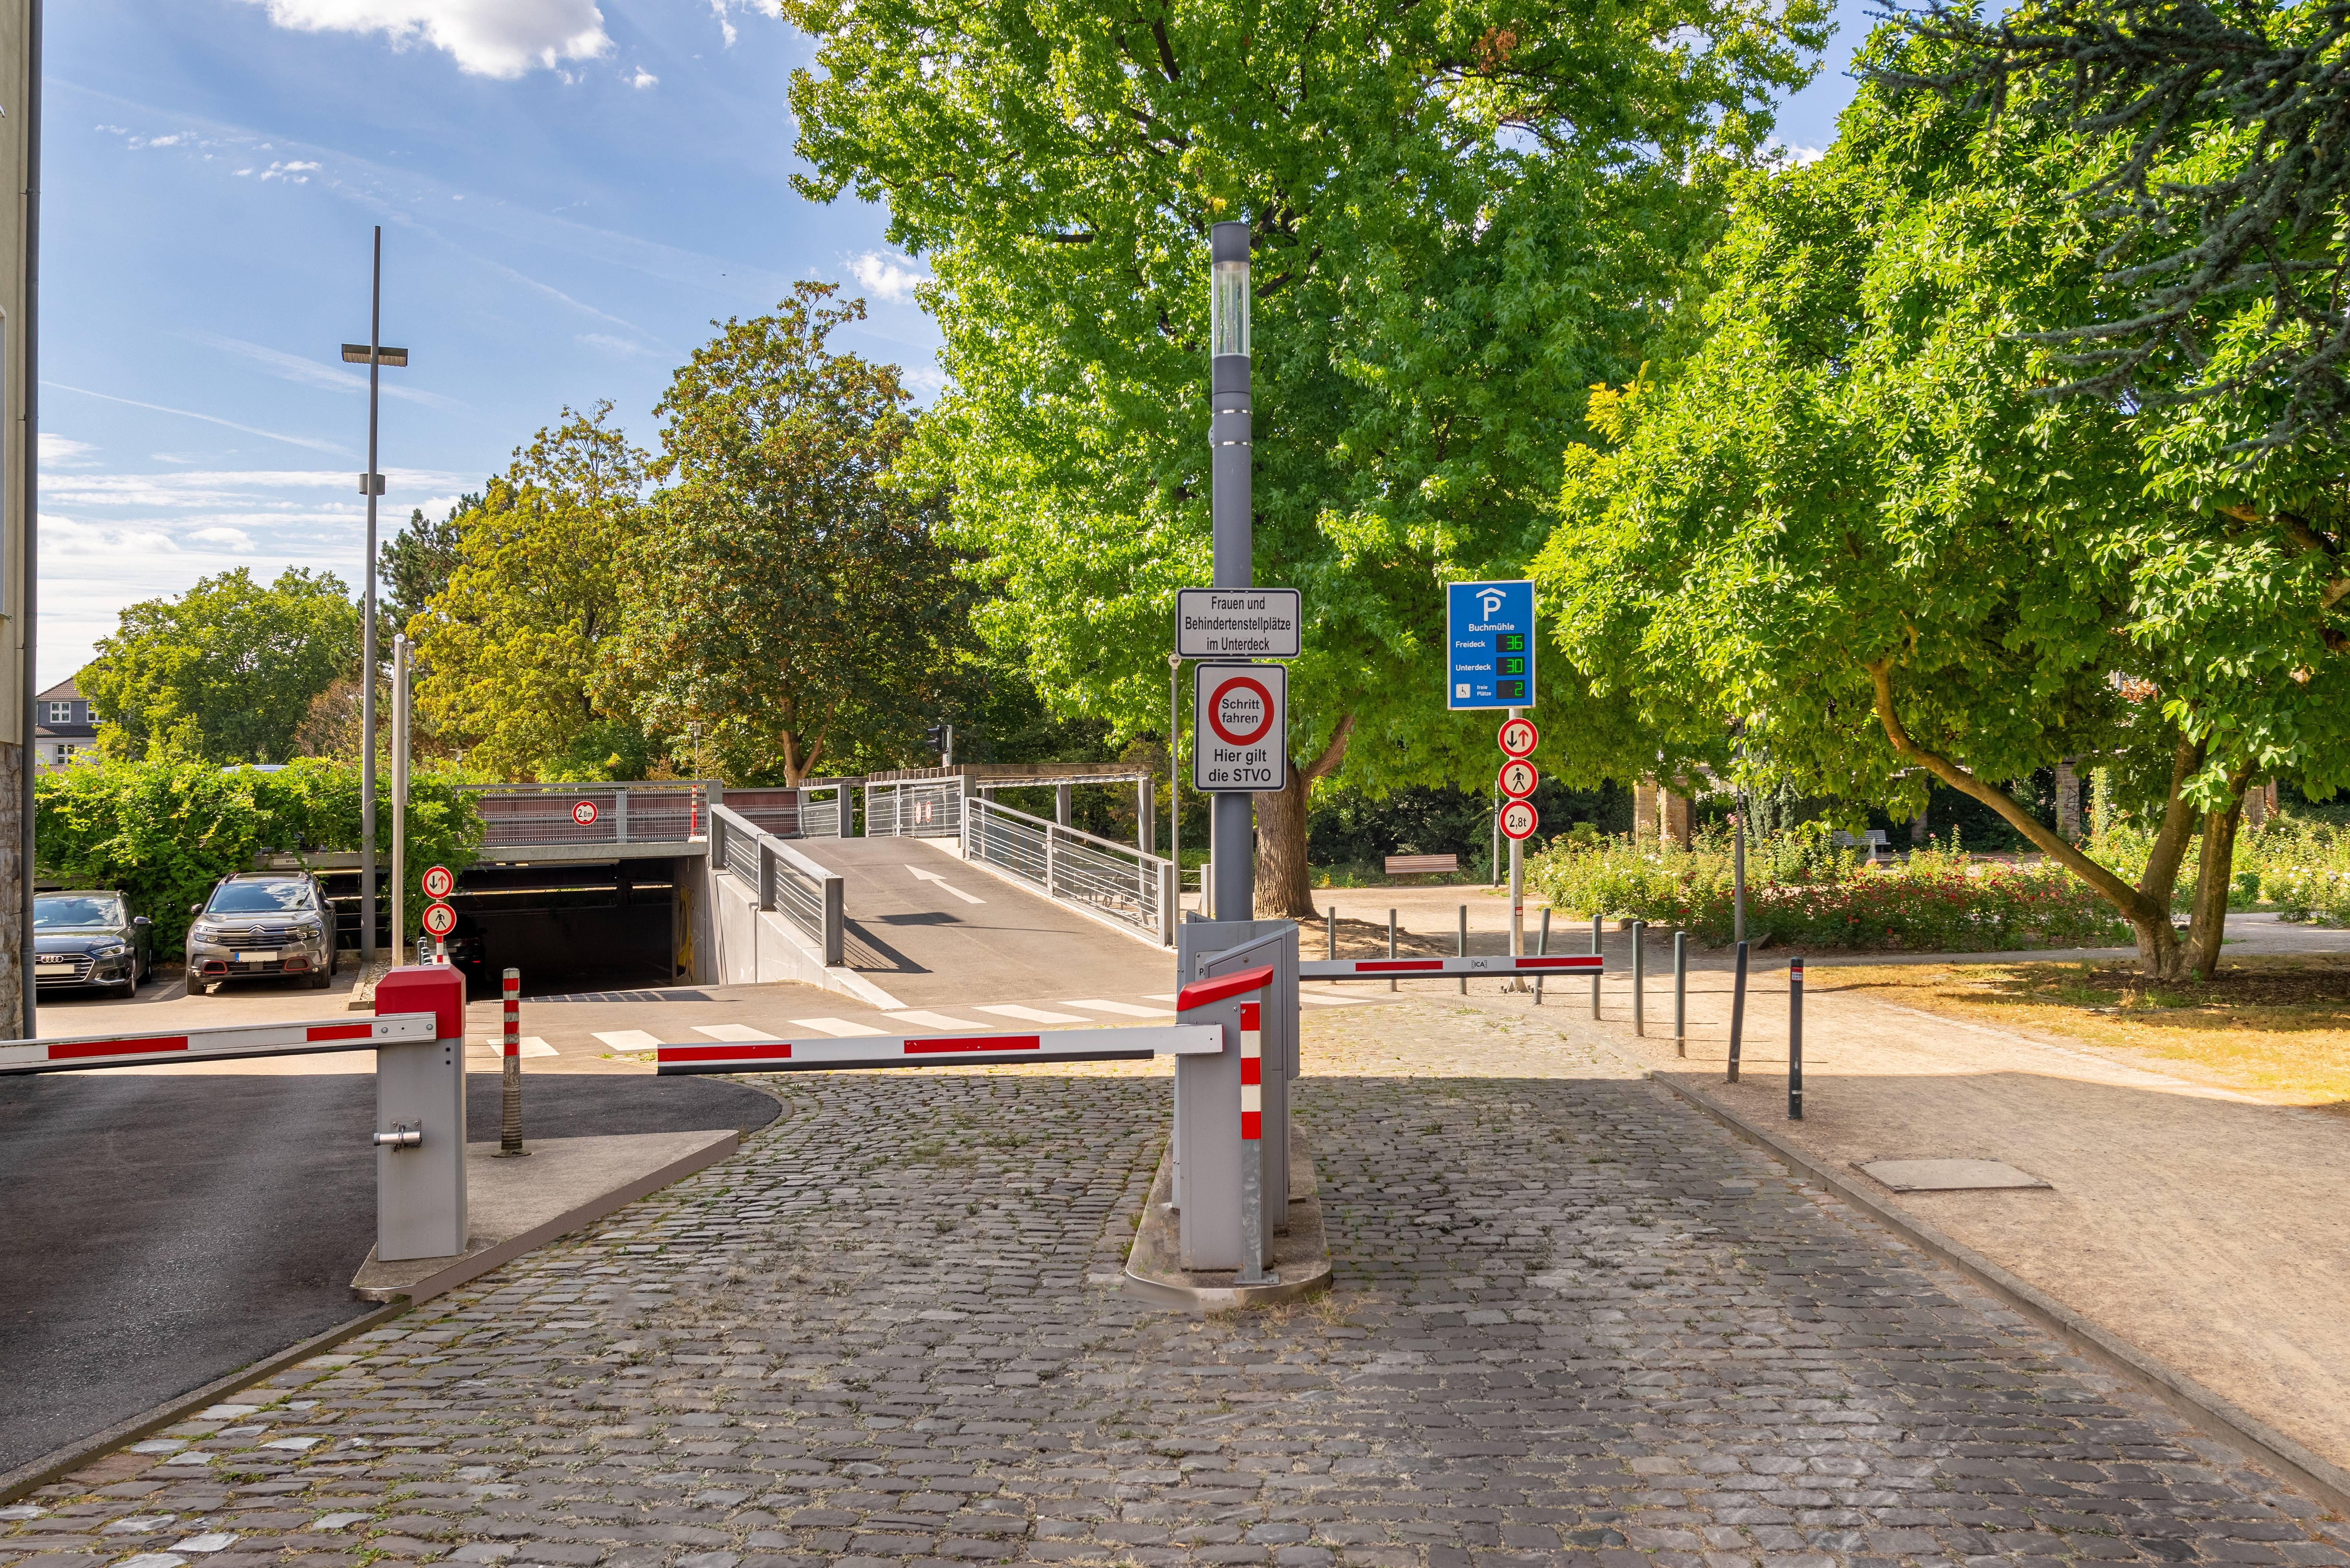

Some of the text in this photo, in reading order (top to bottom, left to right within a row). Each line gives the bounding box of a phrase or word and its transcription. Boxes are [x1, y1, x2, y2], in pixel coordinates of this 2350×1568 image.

[1211, 596, 1265, 610] Frauen und
[1484, 597, 1501, 621] P
[1185, 616, 1291, 633] Behindertenstellplätze
[1469, 623, 1514, 632] Buchmühle
[1207, 637, 1270, 651] im Unterdeck
[1507, 636, 1523, 649] 36
[1507, 659, 1523, 673] 30
[1514, 682, 1523, 696] 2
[1222, 698, 1260, 709] Schritt
[1222, 712, 1258, 723] fahren
[1215, 749, 1267, 765] Hier gilt
[1208, 768, 1271, 782] die STVO
[1509, 815, 1527, 829] 2,8t
